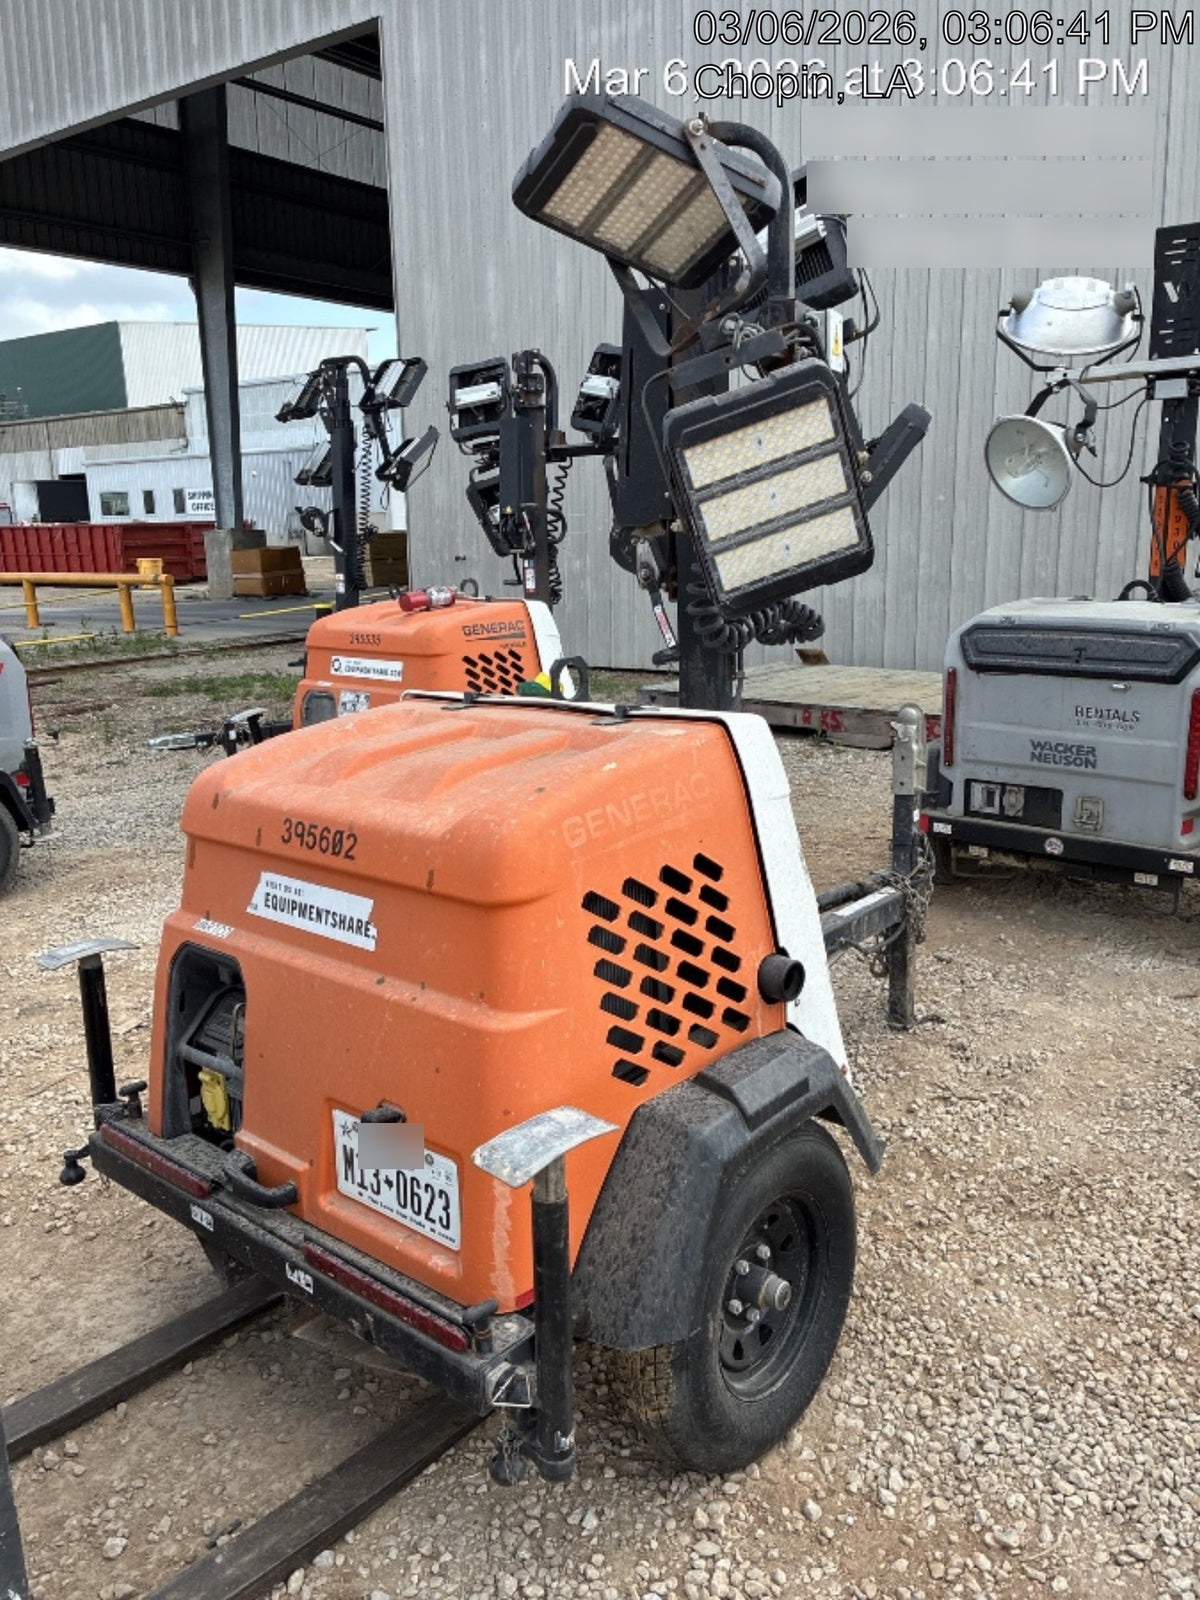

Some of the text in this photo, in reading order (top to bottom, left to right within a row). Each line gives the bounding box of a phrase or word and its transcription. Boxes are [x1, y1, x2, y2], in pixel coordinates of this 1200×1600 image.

[188, 490, 212, 499] SHIPPIN
[462, 620, 525, 637] GENERAC
[1074, 705, 1141, 723] RENTALS
[1029, 739, 1097, 758] WACKER
[1030, 751, 1098, 769] NEUSON
[562, 772, 711, 849] GENERAC
[281, 817, 359, 861] 395602
